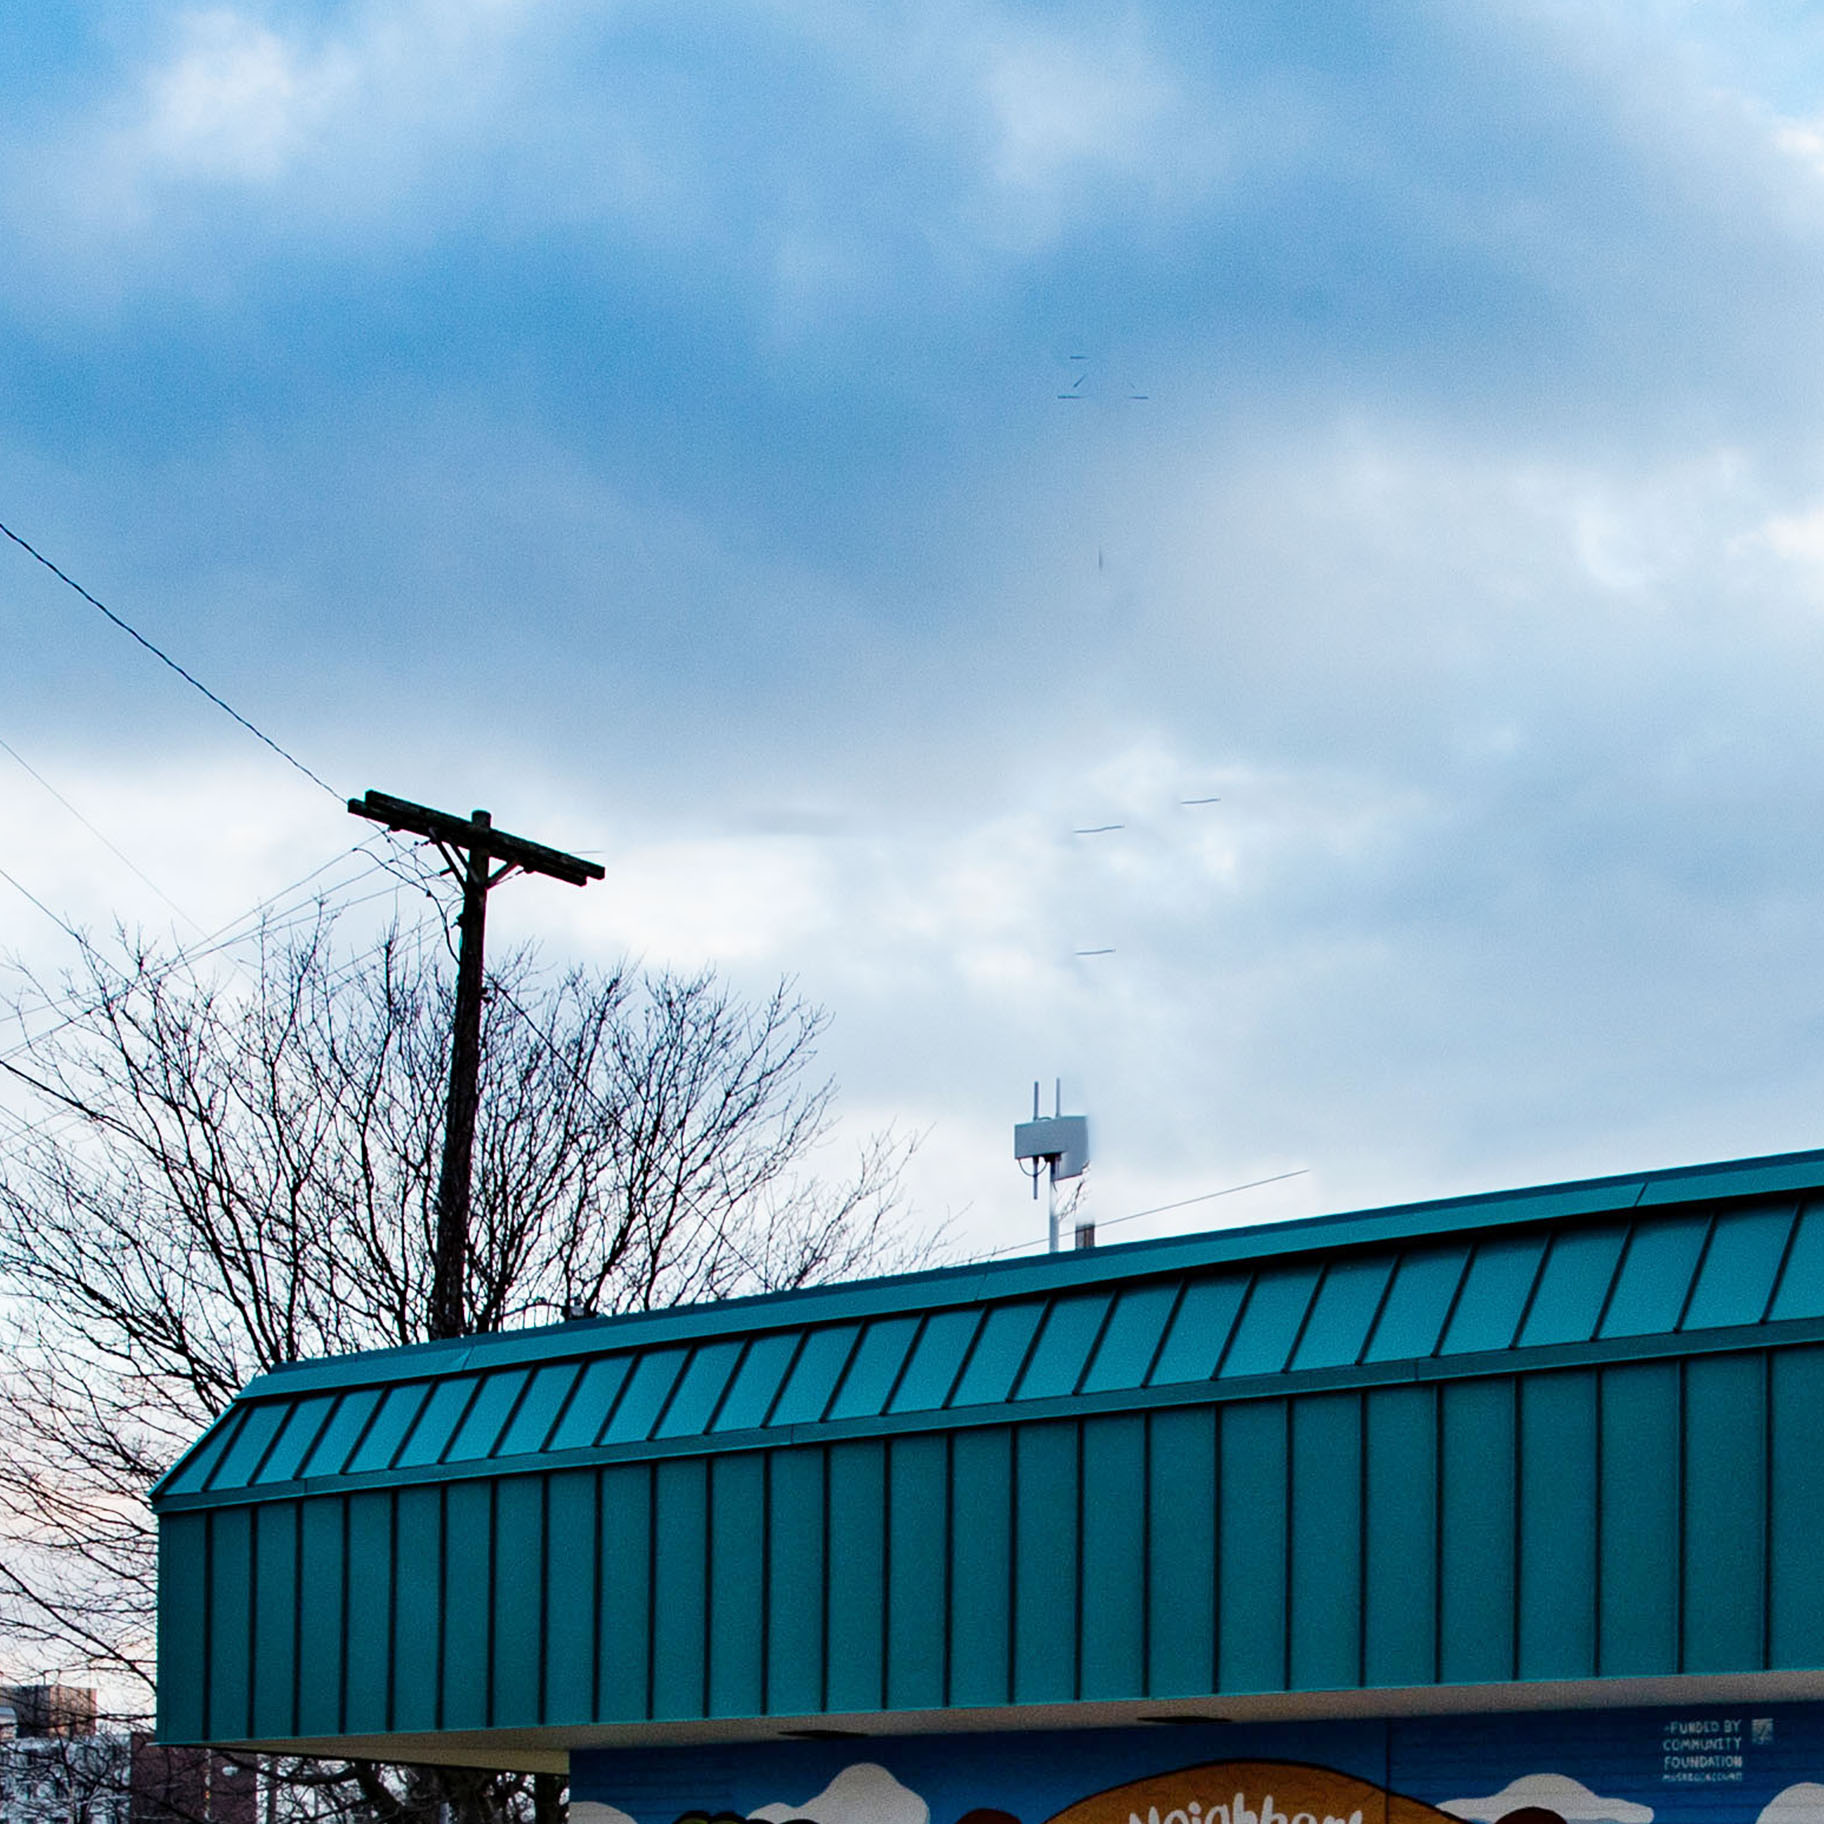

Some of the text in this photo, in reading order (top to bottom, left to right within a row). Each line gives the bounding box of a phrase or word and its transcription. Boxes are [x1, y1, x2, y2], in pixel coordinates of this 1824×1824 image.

[1724, 1719, 1742, 1733] BY
[1662, 1737, 1742, 1751] COMMUNITY
[1664, 1755, 1743, 1770] FOUNDATION
